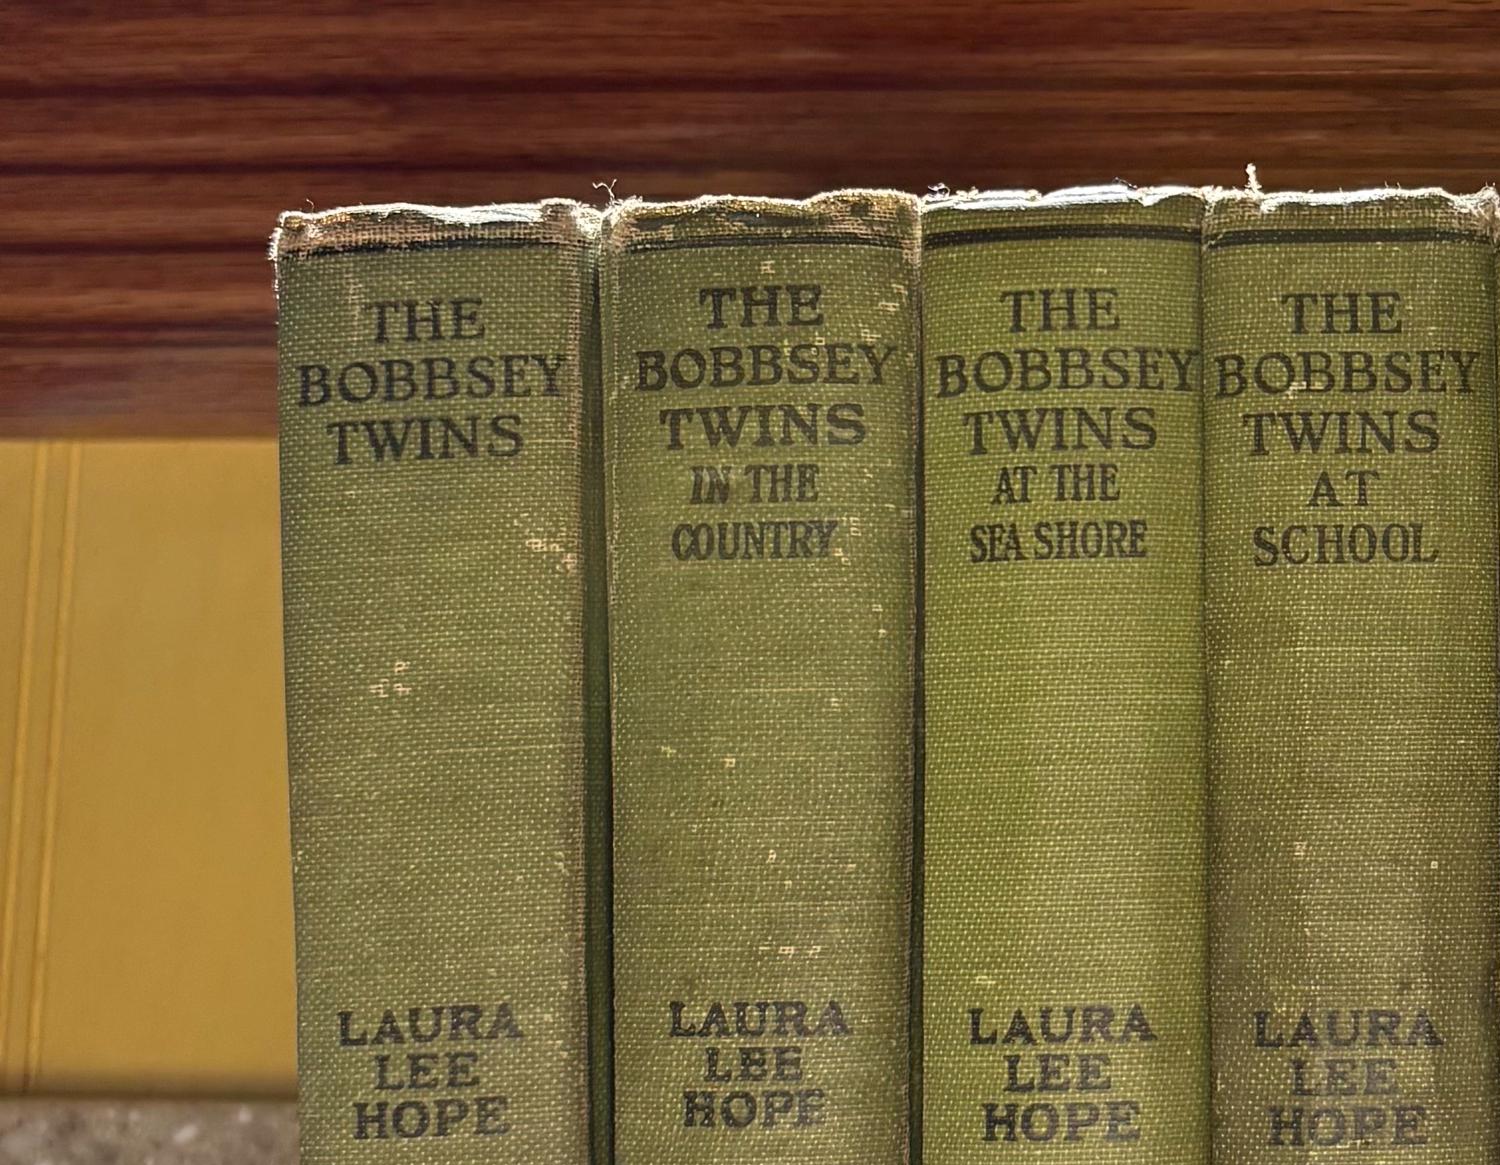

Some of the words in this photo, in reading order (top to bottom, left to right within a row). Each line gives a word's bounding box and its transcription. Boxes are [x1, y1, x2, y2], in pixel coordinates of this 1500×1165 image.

[366, 298, 485, 344] THE
[701, 284, 824, 329] THE
[1001, 287, 1119, 333] THE
[1282, 292, 1402, 334] THE
[299, 354, 566, 406] BOBBSEY
[636, 344, 898, 391] BOBBSEY
[937, 348, 1199, 398] BOBBSEY
[1215, 350, 1481, 399] BOBBSEY
[327, 415, 523, 465] TWINS
[660, 403, 866, 449] TWINS
[963, 407, 1157, 455] TWINS
[1242, 410, 1440, 455] TWINS
[690, 465, 731, 504] IN
[744, 463, 819, 502] THE
[991, 466, 1037, 505] AT
[1051, 463, 1120, 501] THE
[1307, 470, 1380, 507] AT
[672, 521, 837, 560] COUNTRY
[970, 522, 1027, 563] SEA
[1034, 520, 1147, 560] SHORE
[1253, 523, 1438, 567] SCHOOL
[338, 1004, 525, 1047] LAURA
[668, 1001, 849, 1038] LAURA
[968, 1004, 1158, 1046] LAURA
[1253, 1010, 1444, 1048] LAURA
[374, 1052, 479, 1091] LEE
[705, 1046, 802, 1084] LEE
[1002, 1054, 1111, 1094] LEE
[1289, 1058, 1399, 1097] LEE
[352, 1097, 510, 1140] HOPE
[683, 1089, 825, 1128] HOPE
[982, 1101, 1142, 1142] HOPE
[1268, 1104, 1430, 1147] HOPE
